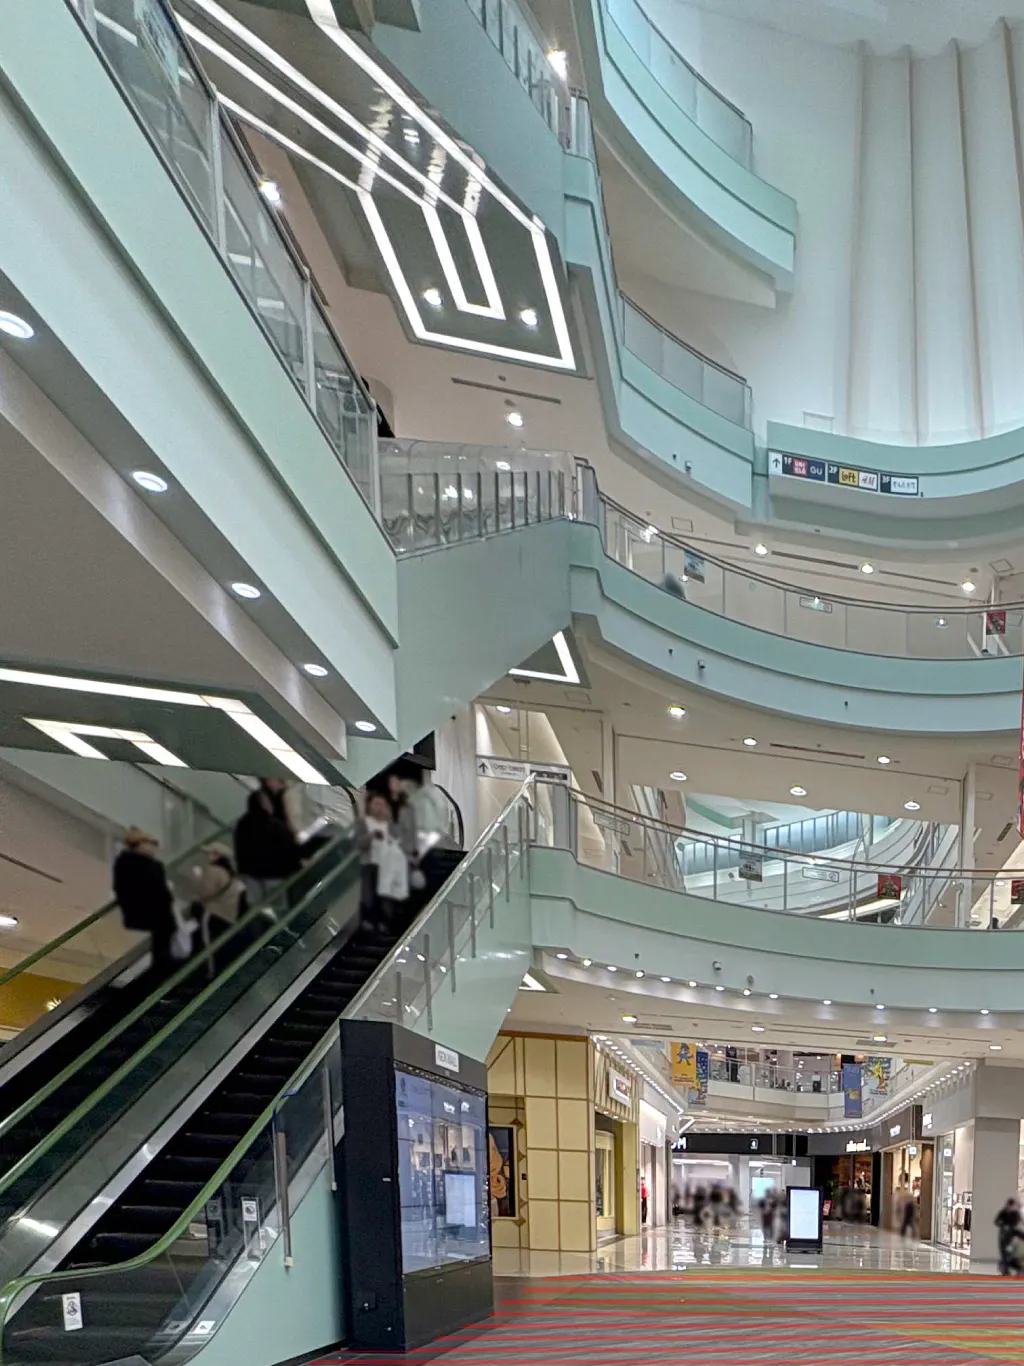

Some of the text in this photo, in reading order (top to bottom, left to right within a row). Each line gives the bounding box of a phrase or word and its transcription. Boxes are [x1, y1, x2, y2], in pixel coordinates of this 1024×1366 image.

[784, 457, 793, 465] 1F
[810, 465, 823, 475] GU
[828, 465, 838, 474] 2F
[881, 475, 891, 484] 3F
